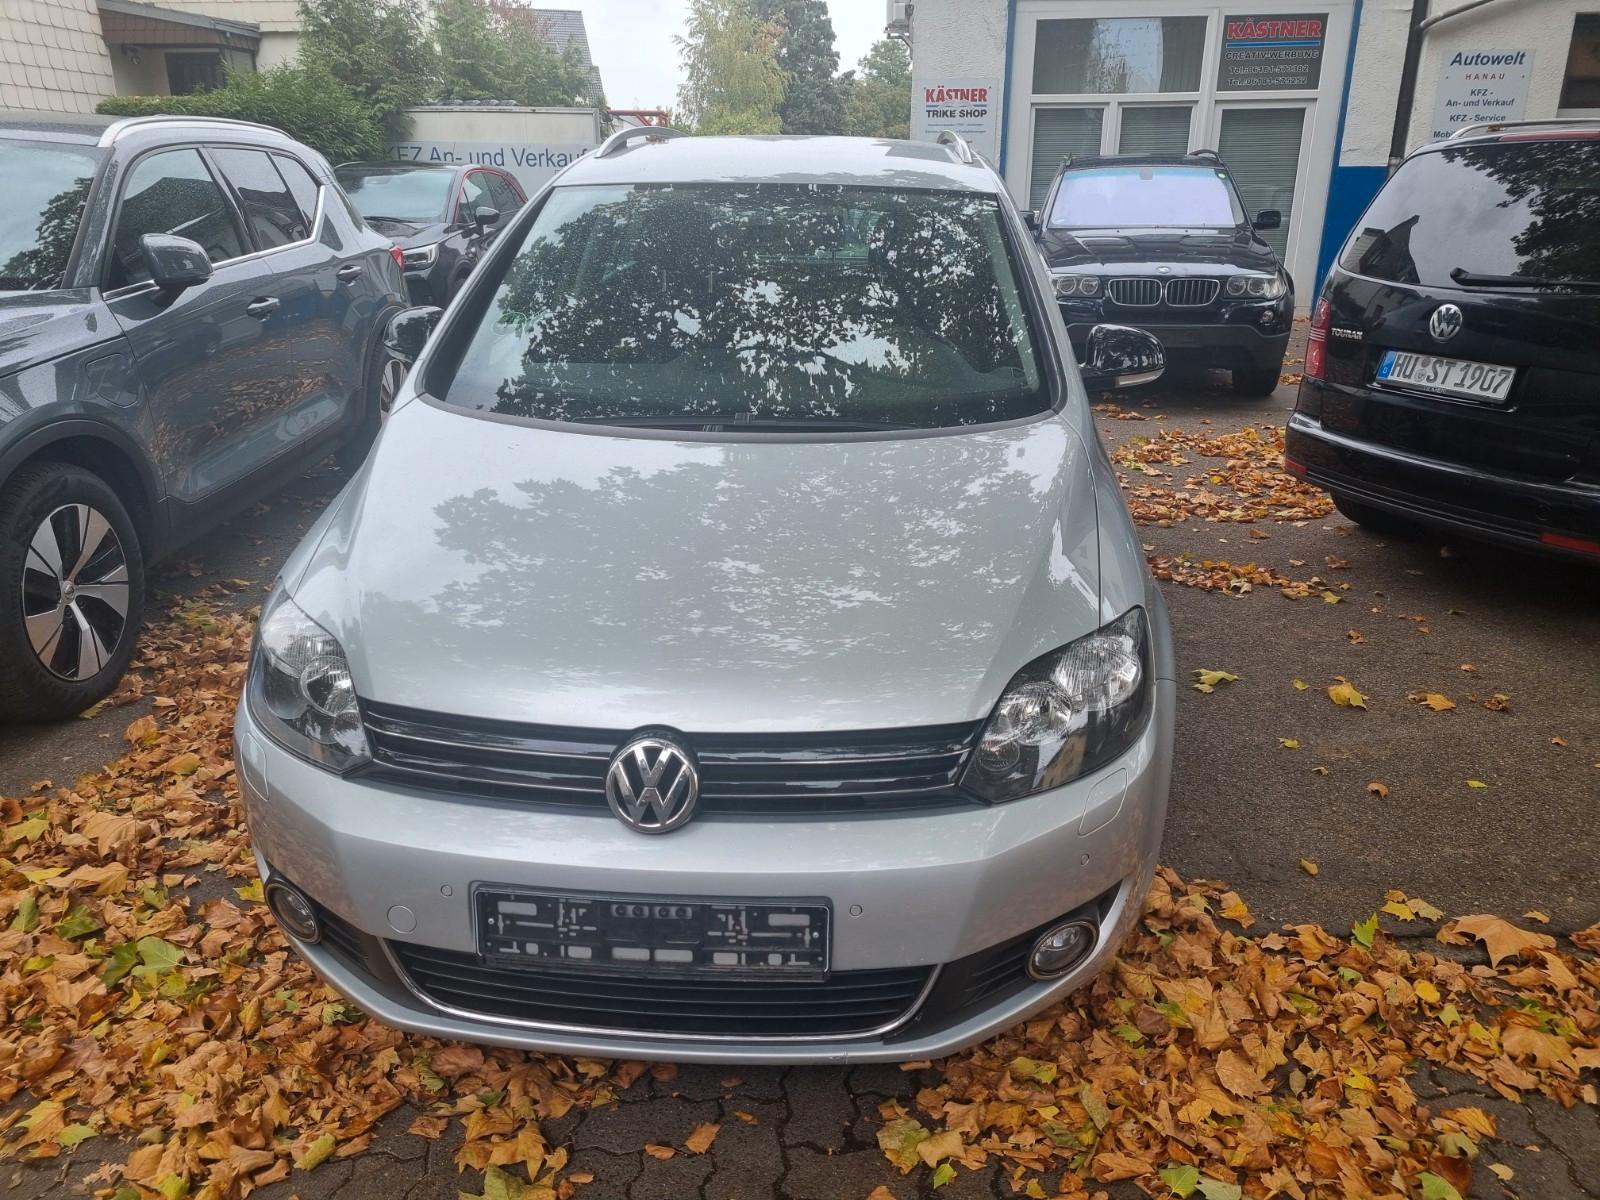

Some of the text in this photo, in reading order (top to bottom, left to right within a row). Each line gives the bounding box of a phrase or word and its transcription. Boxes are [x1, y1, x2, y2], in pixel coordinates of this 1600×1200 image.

[1227, 17, 1322, 39] KÄSTNER
[1450, 51, 1526, 66] Autowelt
[925, 85, 988, 102] KÄSTNER
[1446, 99, 1462, 107] An-
[1482, 98, 1515, 107] Verkauf
[926, 109, 988, 118] TRIKE SHOP
[1474, 114, 1506, 122] Service
[430, 146, 463, 162] An-
[469, 148, 504, 167] und
[1331, 327, 1363, 340] TOURAN
[1391, 353, 1420, 379] HU
[1426, 358, 1457, 385] ST
[1454, 363, 1512, 394] 1907
